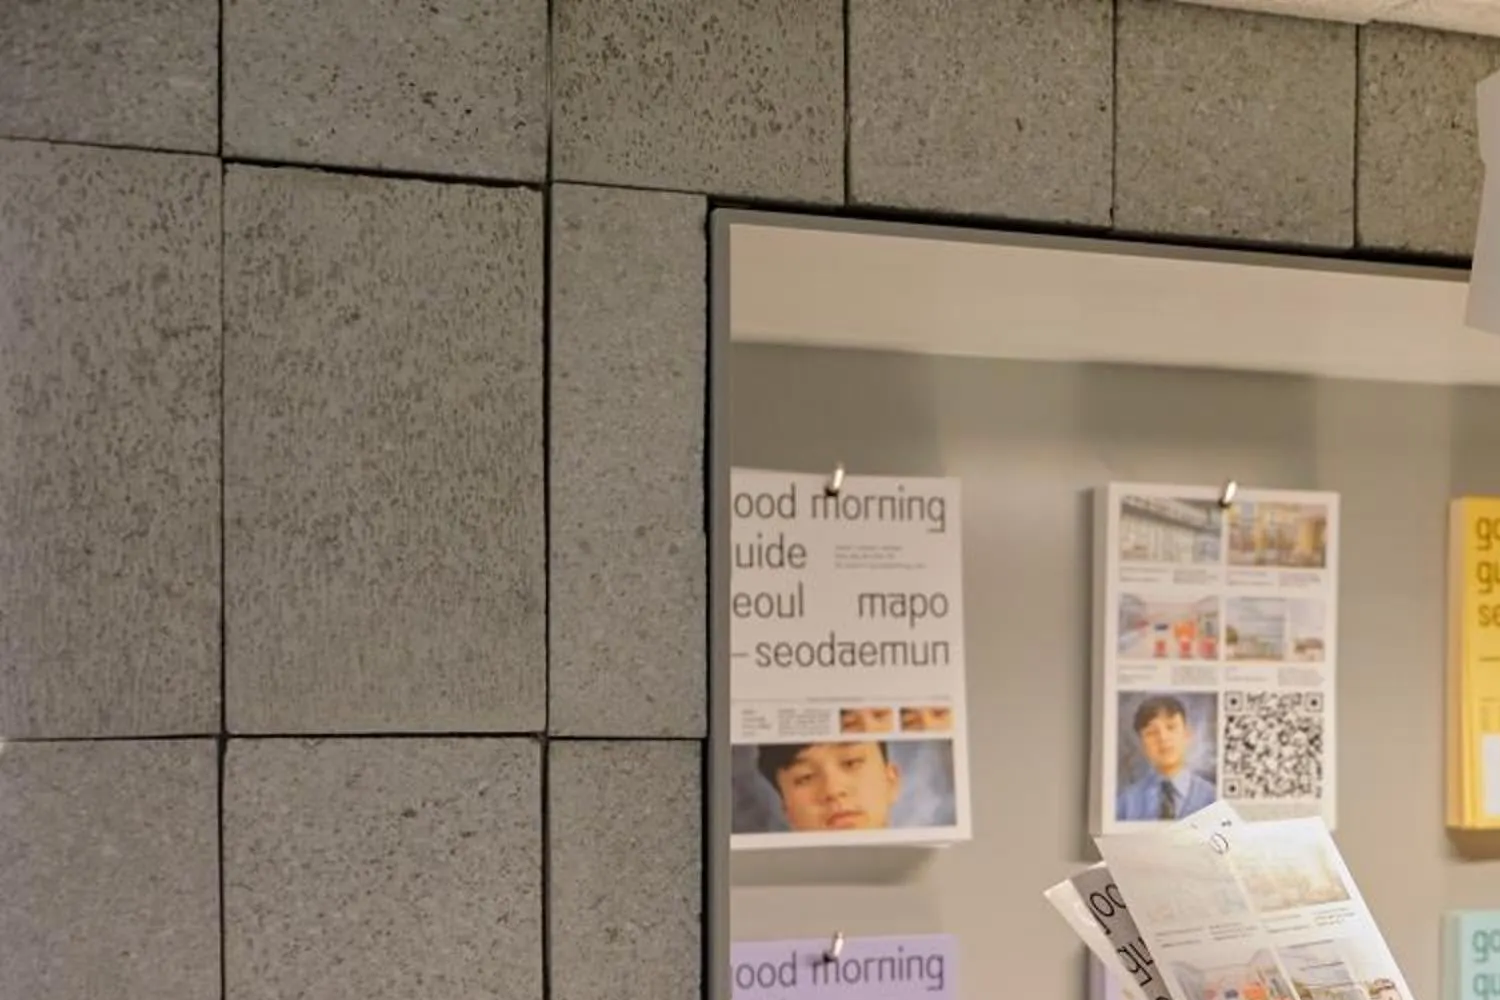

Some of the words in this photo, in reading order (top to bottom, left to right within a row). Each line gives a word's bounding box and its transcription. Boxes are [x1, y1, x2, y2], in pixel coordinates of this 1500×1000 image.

[733, 482, 797, 519] ood
[810, 484, 946, 533] morning
[734, 532, 808, 570] uide
[732, 580, 804, 619] eoul
[857, 591, 949, 629] mapo
[754, 630, 950, 668] seodaemun
[735, 952, 797, 990] ood
[811, 946, 945, 991] morning
